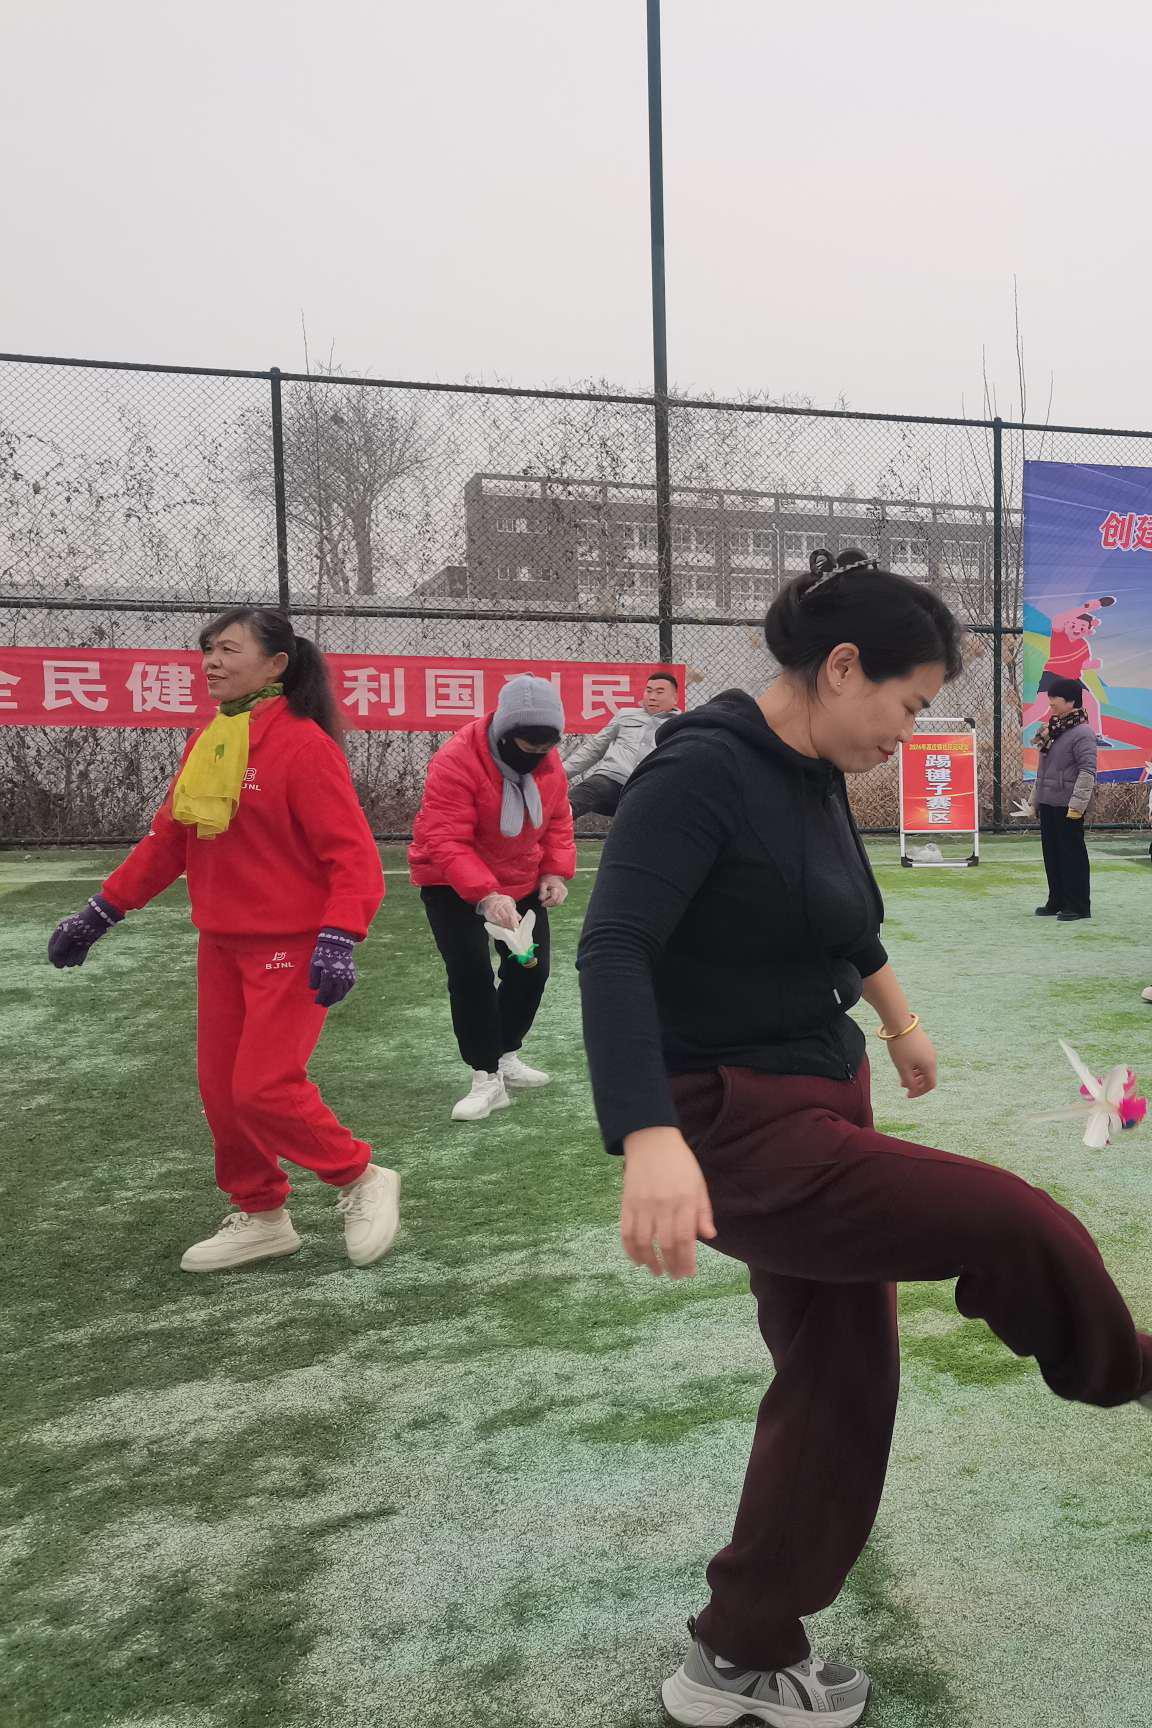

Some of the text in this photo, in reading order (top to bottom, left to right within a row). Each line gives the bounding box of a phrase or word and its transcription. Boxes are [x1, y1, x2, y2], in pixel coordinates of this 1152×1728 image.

[343, 667, 635, 719] 利国民
[240, 783, 261, 791] JNL
